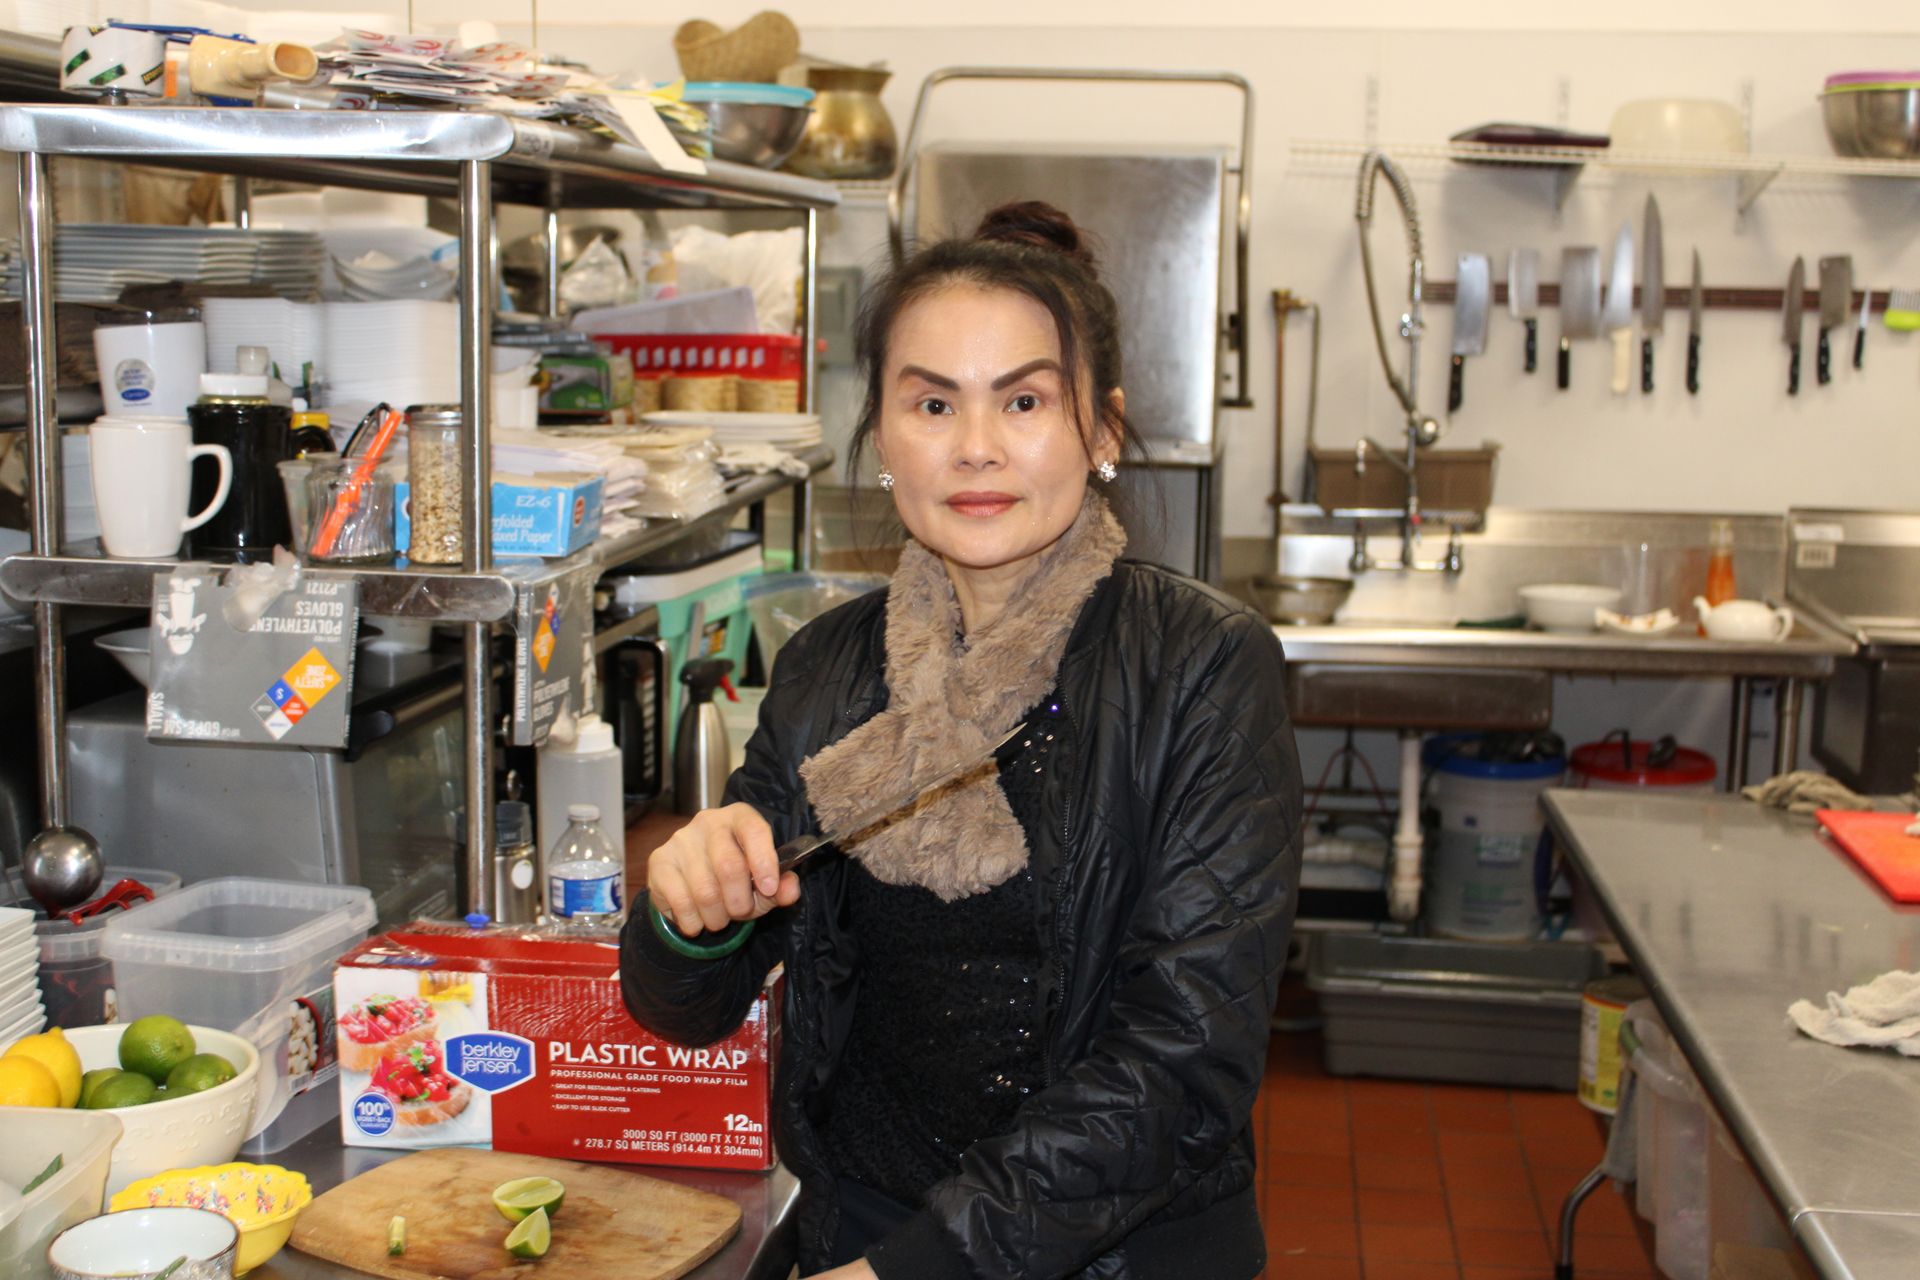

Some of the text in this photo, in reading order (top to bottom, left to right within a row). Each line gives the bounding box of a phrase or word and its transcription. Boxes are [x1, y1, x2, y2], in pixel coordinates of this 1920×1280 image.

[514, 495, 550, 508] EZ-6
[492, 529, 552, 545] axed Paper
[306, 582, 338, 595] P2121
[296, 602, 344, 617] GLOVES
[250, 617, 342, 634] POLYETHYLEN
[149, 691, 164, 732] SMALL
[461, 1040, 521, 1061] berkley
[549, 1041, 748, 1070] PLASTIC WRAP
[461, 1060, 517, 1076] jensen
[550, 1070, 748, 1086] PROFESSIONAL GRADE FOOD WRAP FILM
[723, 1113, 763, 1132] 12in
[623, 1129, 763, 1146] 3000 SQ FT (3000 FT X 12 IN)
[586, 1138, 763, 1158] 278.7 SQ METERS (914.4m X 304mm)
